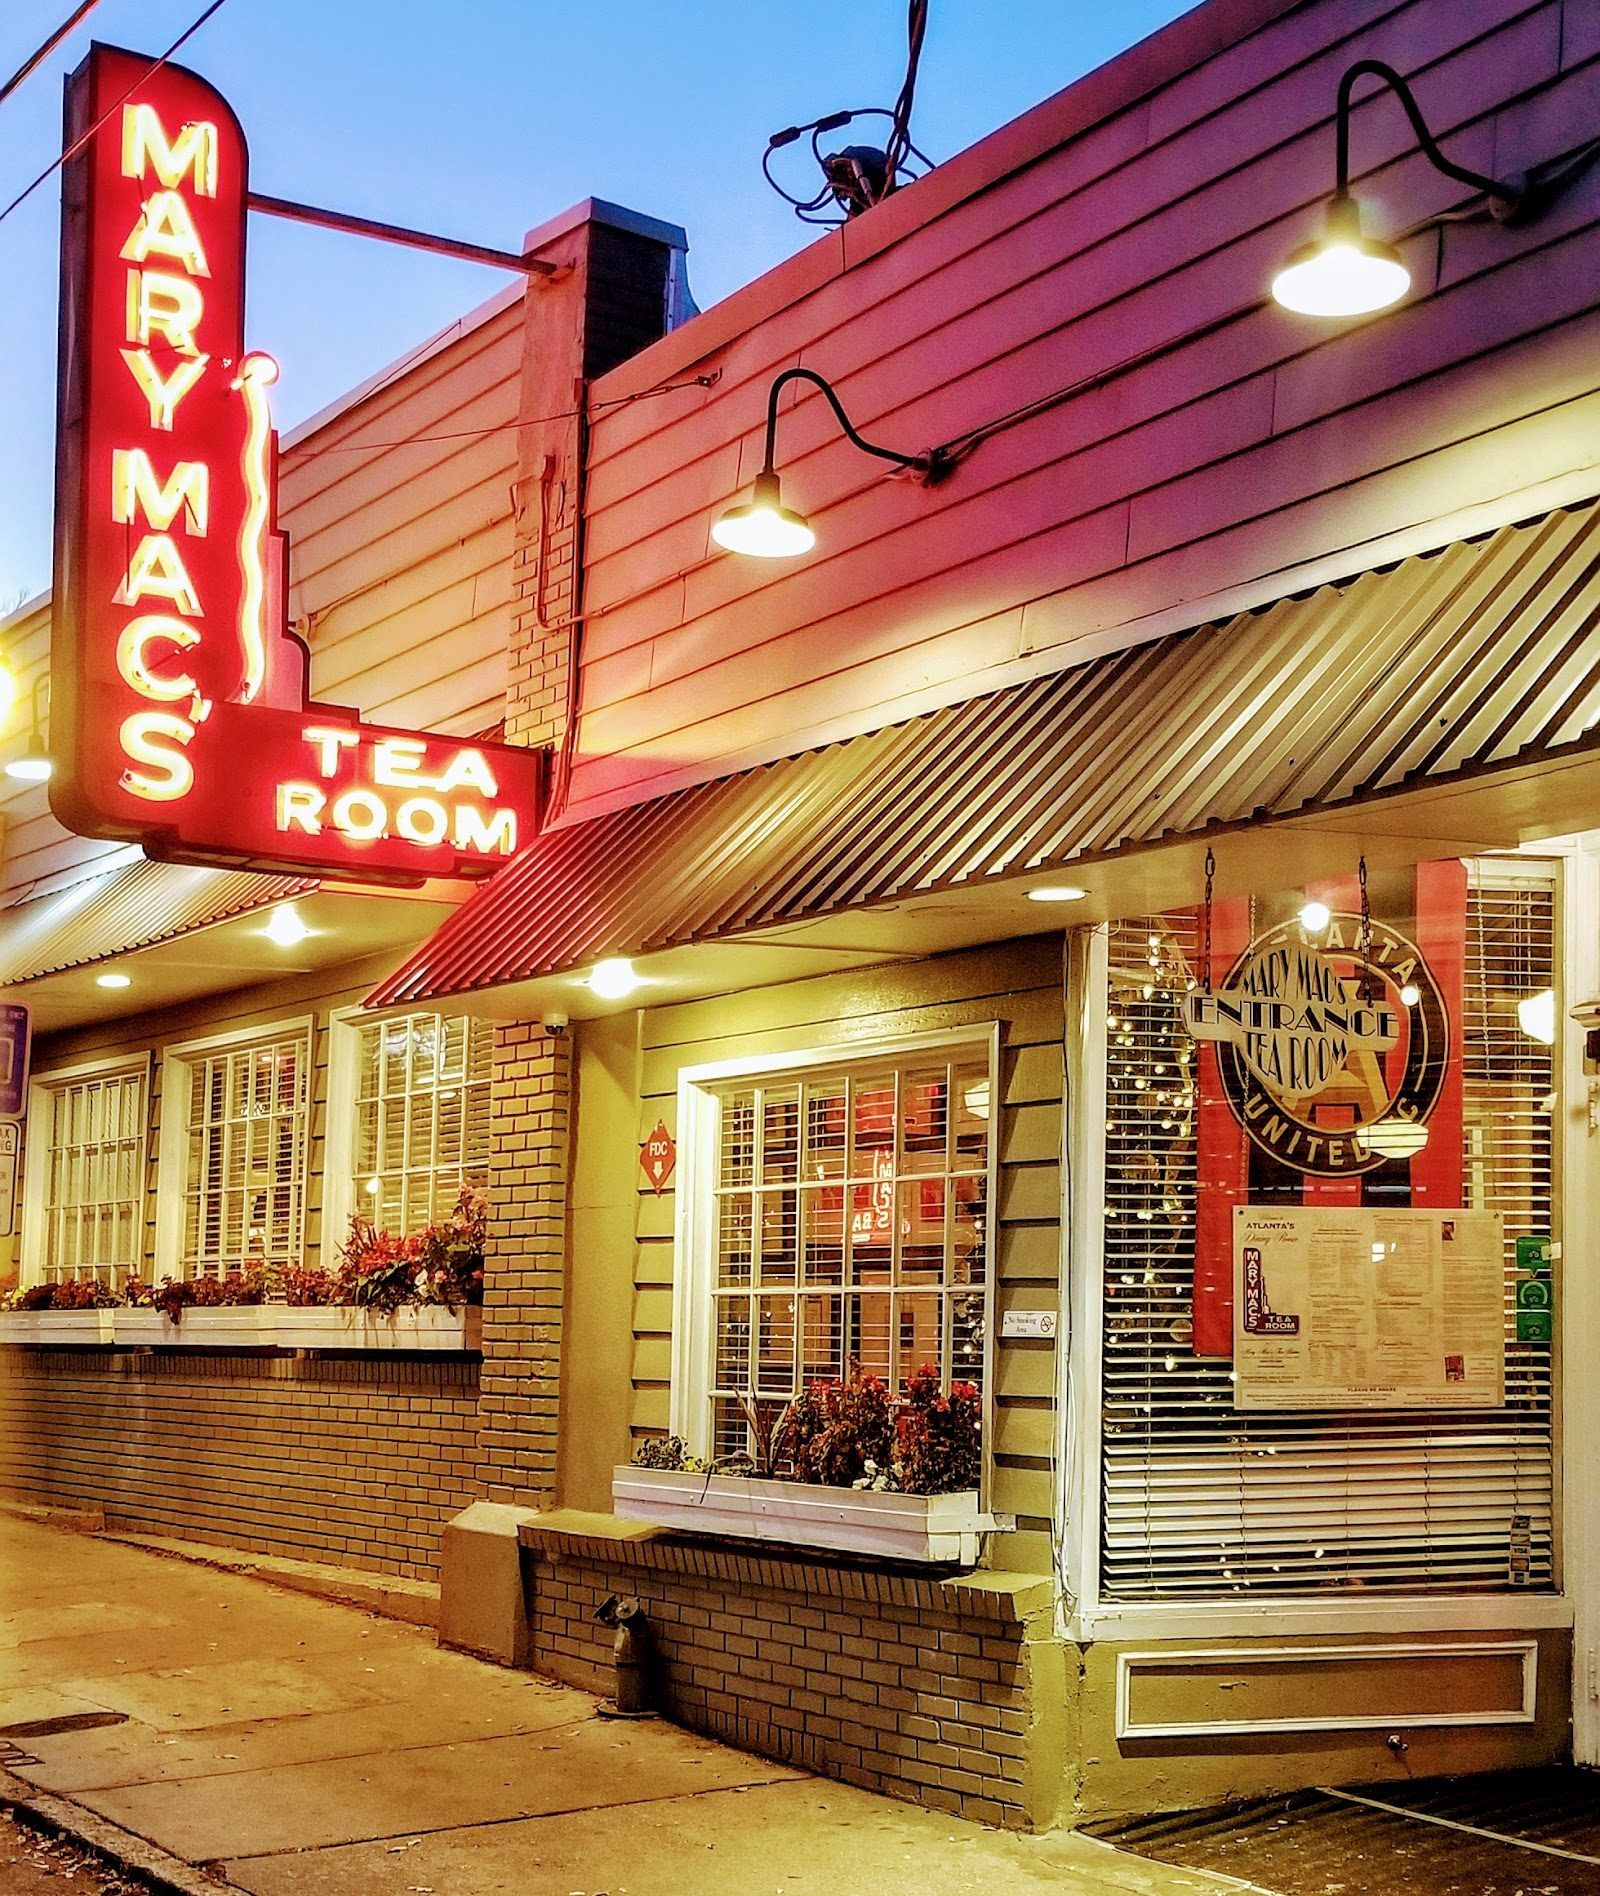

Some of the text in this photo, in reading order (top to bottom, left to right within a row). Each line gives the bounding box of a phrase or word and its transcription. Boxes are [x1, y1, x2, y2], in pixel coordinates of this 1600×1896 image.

[110, 103, 218, 802] MARY MAC'S
[302, 726, 498, 798] TEA
[276, 783, 517, 856] ROOM
[1242, 949, 1346, 1005] MARY MAC'S
[1190, 996, 1399, 1038] ENTRANCE
[1243, 1031, 1348, 1091] TEA ROOM
[649, 1141, 668, 1157] FDC
[1246, 1221, 1295, 1230] ATLANTA'S
[1247, 1251, 1259, 1287] MARY
[1268, 1315, 1292, 1323] TEA
